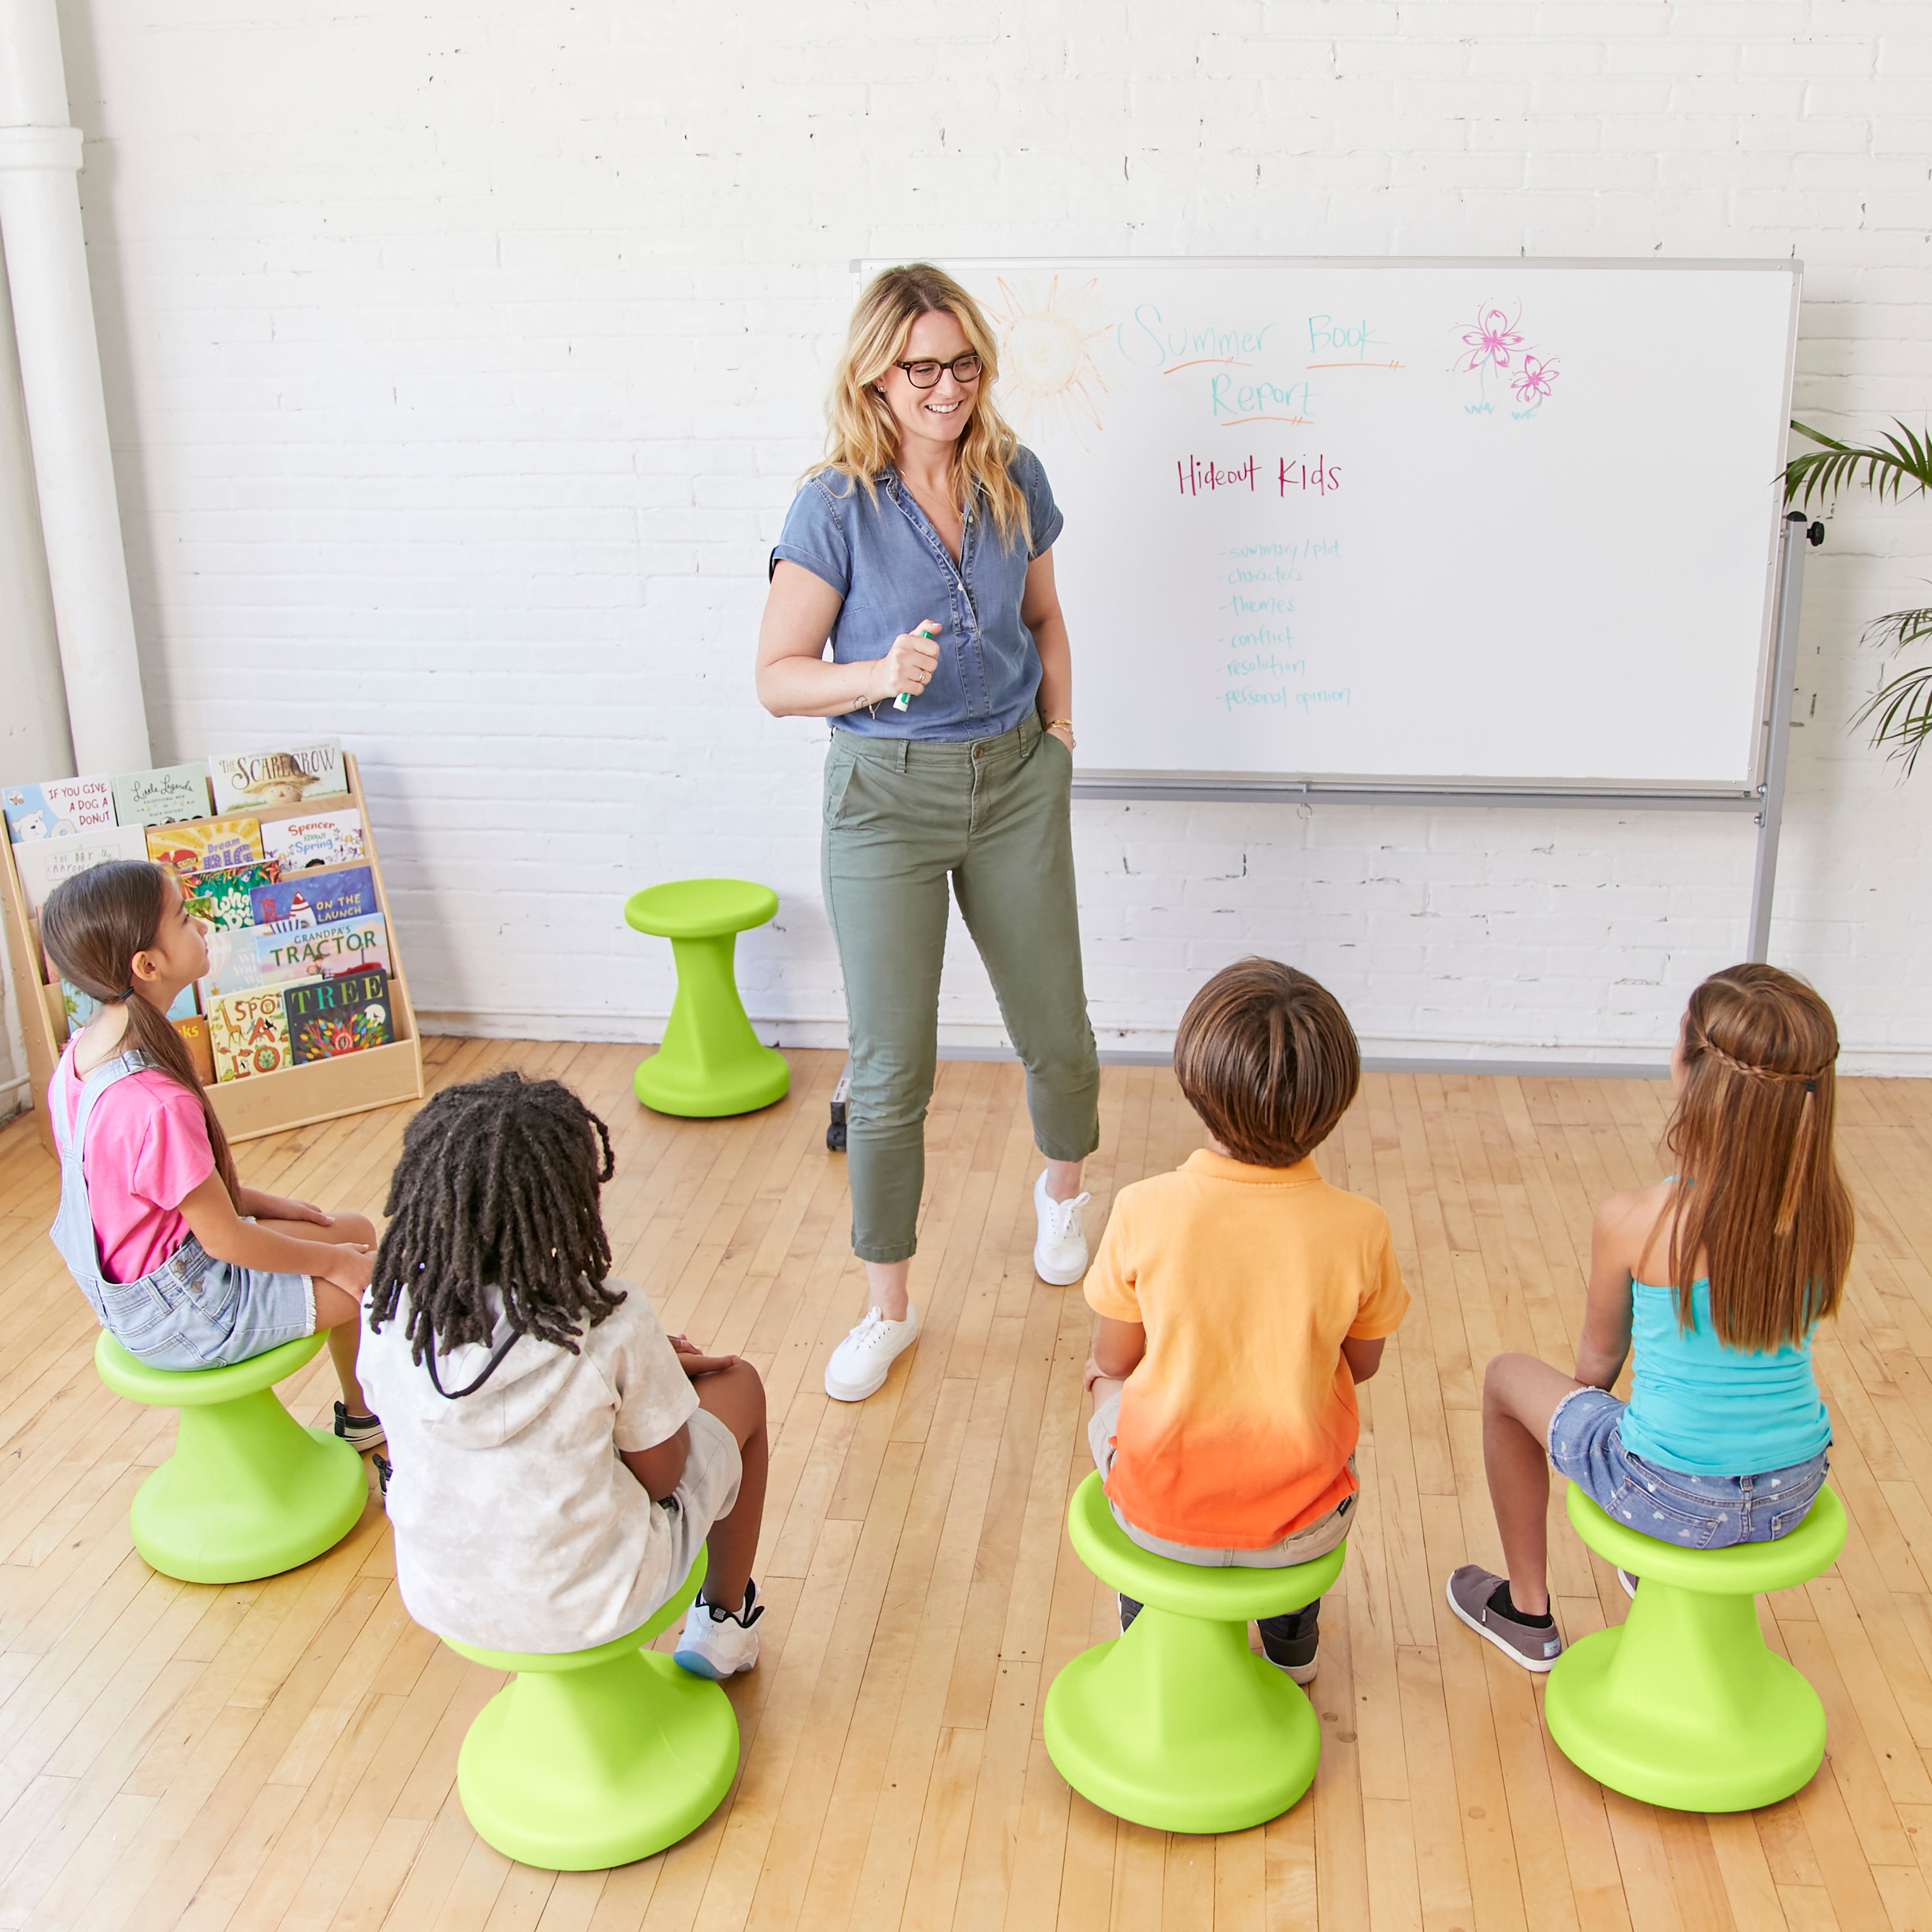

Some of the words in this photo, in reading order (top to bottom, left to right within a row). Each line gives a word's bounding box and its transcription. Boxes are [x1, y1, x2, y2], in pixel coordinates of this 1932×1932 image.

[1117, 303, 1275, 368] Summer
[1308, 314, 1390, 360] Book
[1211, 372, 1322, 416] Report
[1177, 454, 1262, 497] Hideout
[1278, 454, 1342, 498] Kids
[1295, 687, 1351, 714] opinion
[231, 748, 335, 790] SCARECROW
[48, 789, 58, 800] IF
[61, 786, 80, 797] YOU
[83, 783, 107, 794] GIVE
[160, 774, 194, 795] Legends
[70, 802, 75, 812] A
[78, 799, 99, 810] DOG
[102, 797, 108, 807] A
[79, 811, 110, 825] DONUT
[288, 822, 335, 836] Spencer
[208, 838, 241, 853] Dream
[295, 839, 333, 855] Spring
[75, 852, 94, 862] DAY
[203, 844, 254, 869] BIG
[316, 900, 333, 910] ON
[338, 894, 361, 906] THE
[318, 906, 361, 922] LAUNCH
[295, 925, 351, 943] GRANDPA'S
[270, 931, 376, 966] TRACTOR
[291, 975, 383, 1015] TREE
[248, 1017, 275, 1046] A
